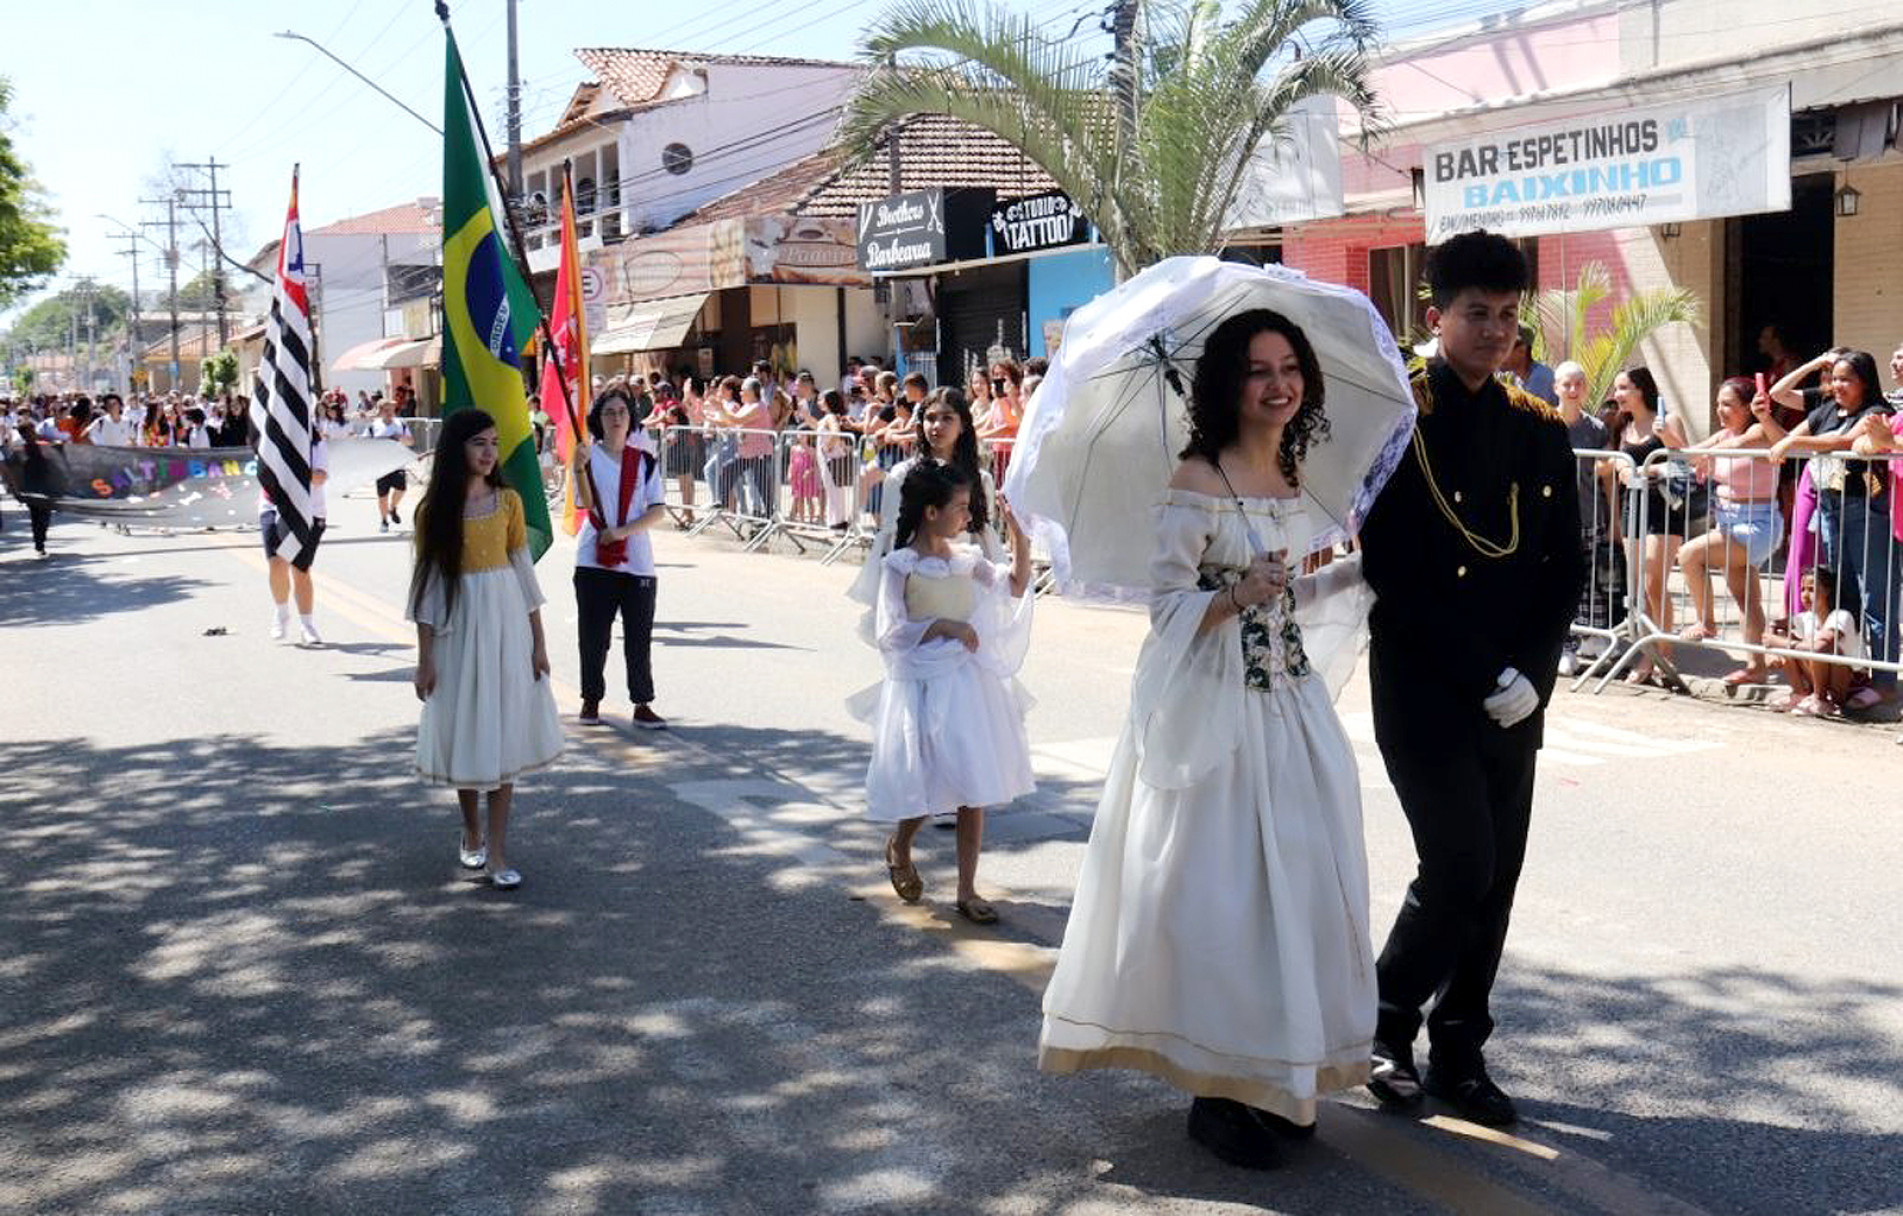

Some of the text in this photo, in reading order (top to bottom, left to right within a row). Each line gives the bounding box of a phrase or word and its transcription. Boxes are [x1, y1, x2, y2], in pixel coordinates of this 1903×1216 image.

[1436, 119, 1659, 182] BAR ESPETINHOS
[1464, 157, 1681, 208] BAIXINHO
[877, 198, 925, 228] Brothers
[1009, 214, 1068, 250] TATTOO
[866, 238, 932, 268] Barbearia
